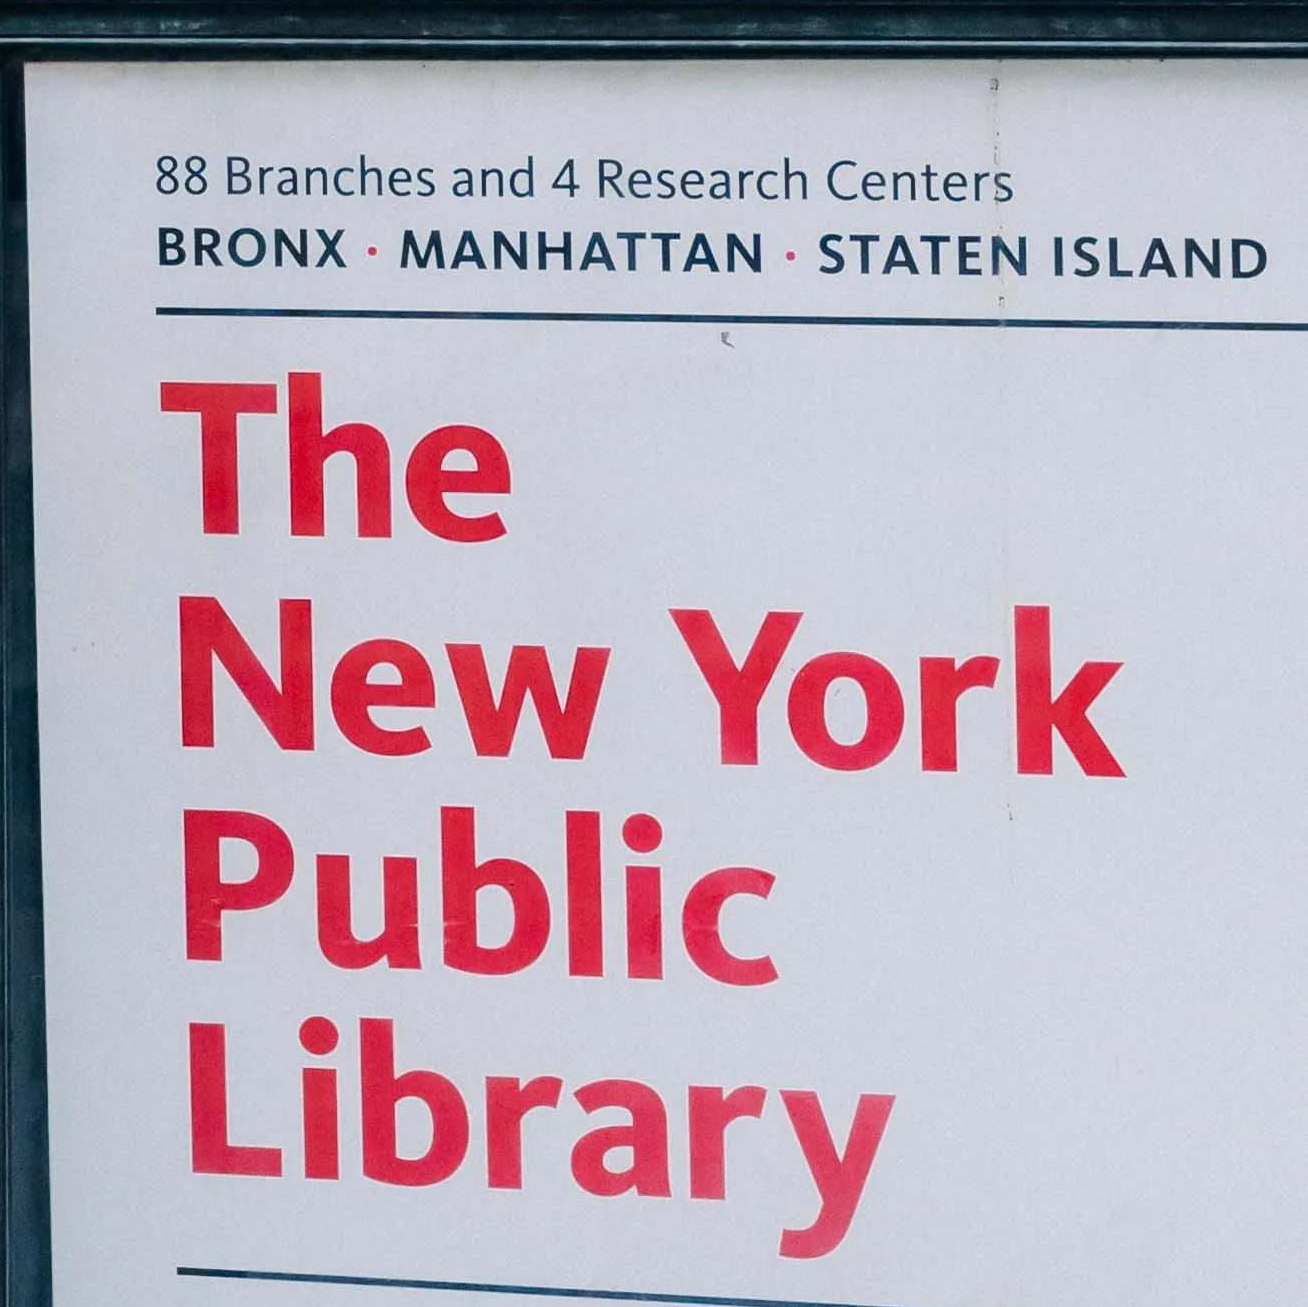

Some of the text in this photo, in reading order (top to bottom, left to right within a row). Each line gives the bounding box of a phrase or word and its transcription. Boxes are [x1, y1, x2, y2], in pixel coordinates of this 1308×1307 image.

[156, 154, 1013, 203] 88 Branches and 4 Research Centers
[158, 227, 1268, 279] BRONX MANHATTAN STATEN ISLAND
[160, 371, 512, 544] The
[177, 595, 1126, 779] New York
[182, 805, 779, 986] Public
[188, 1016, 894, 1259] Library
